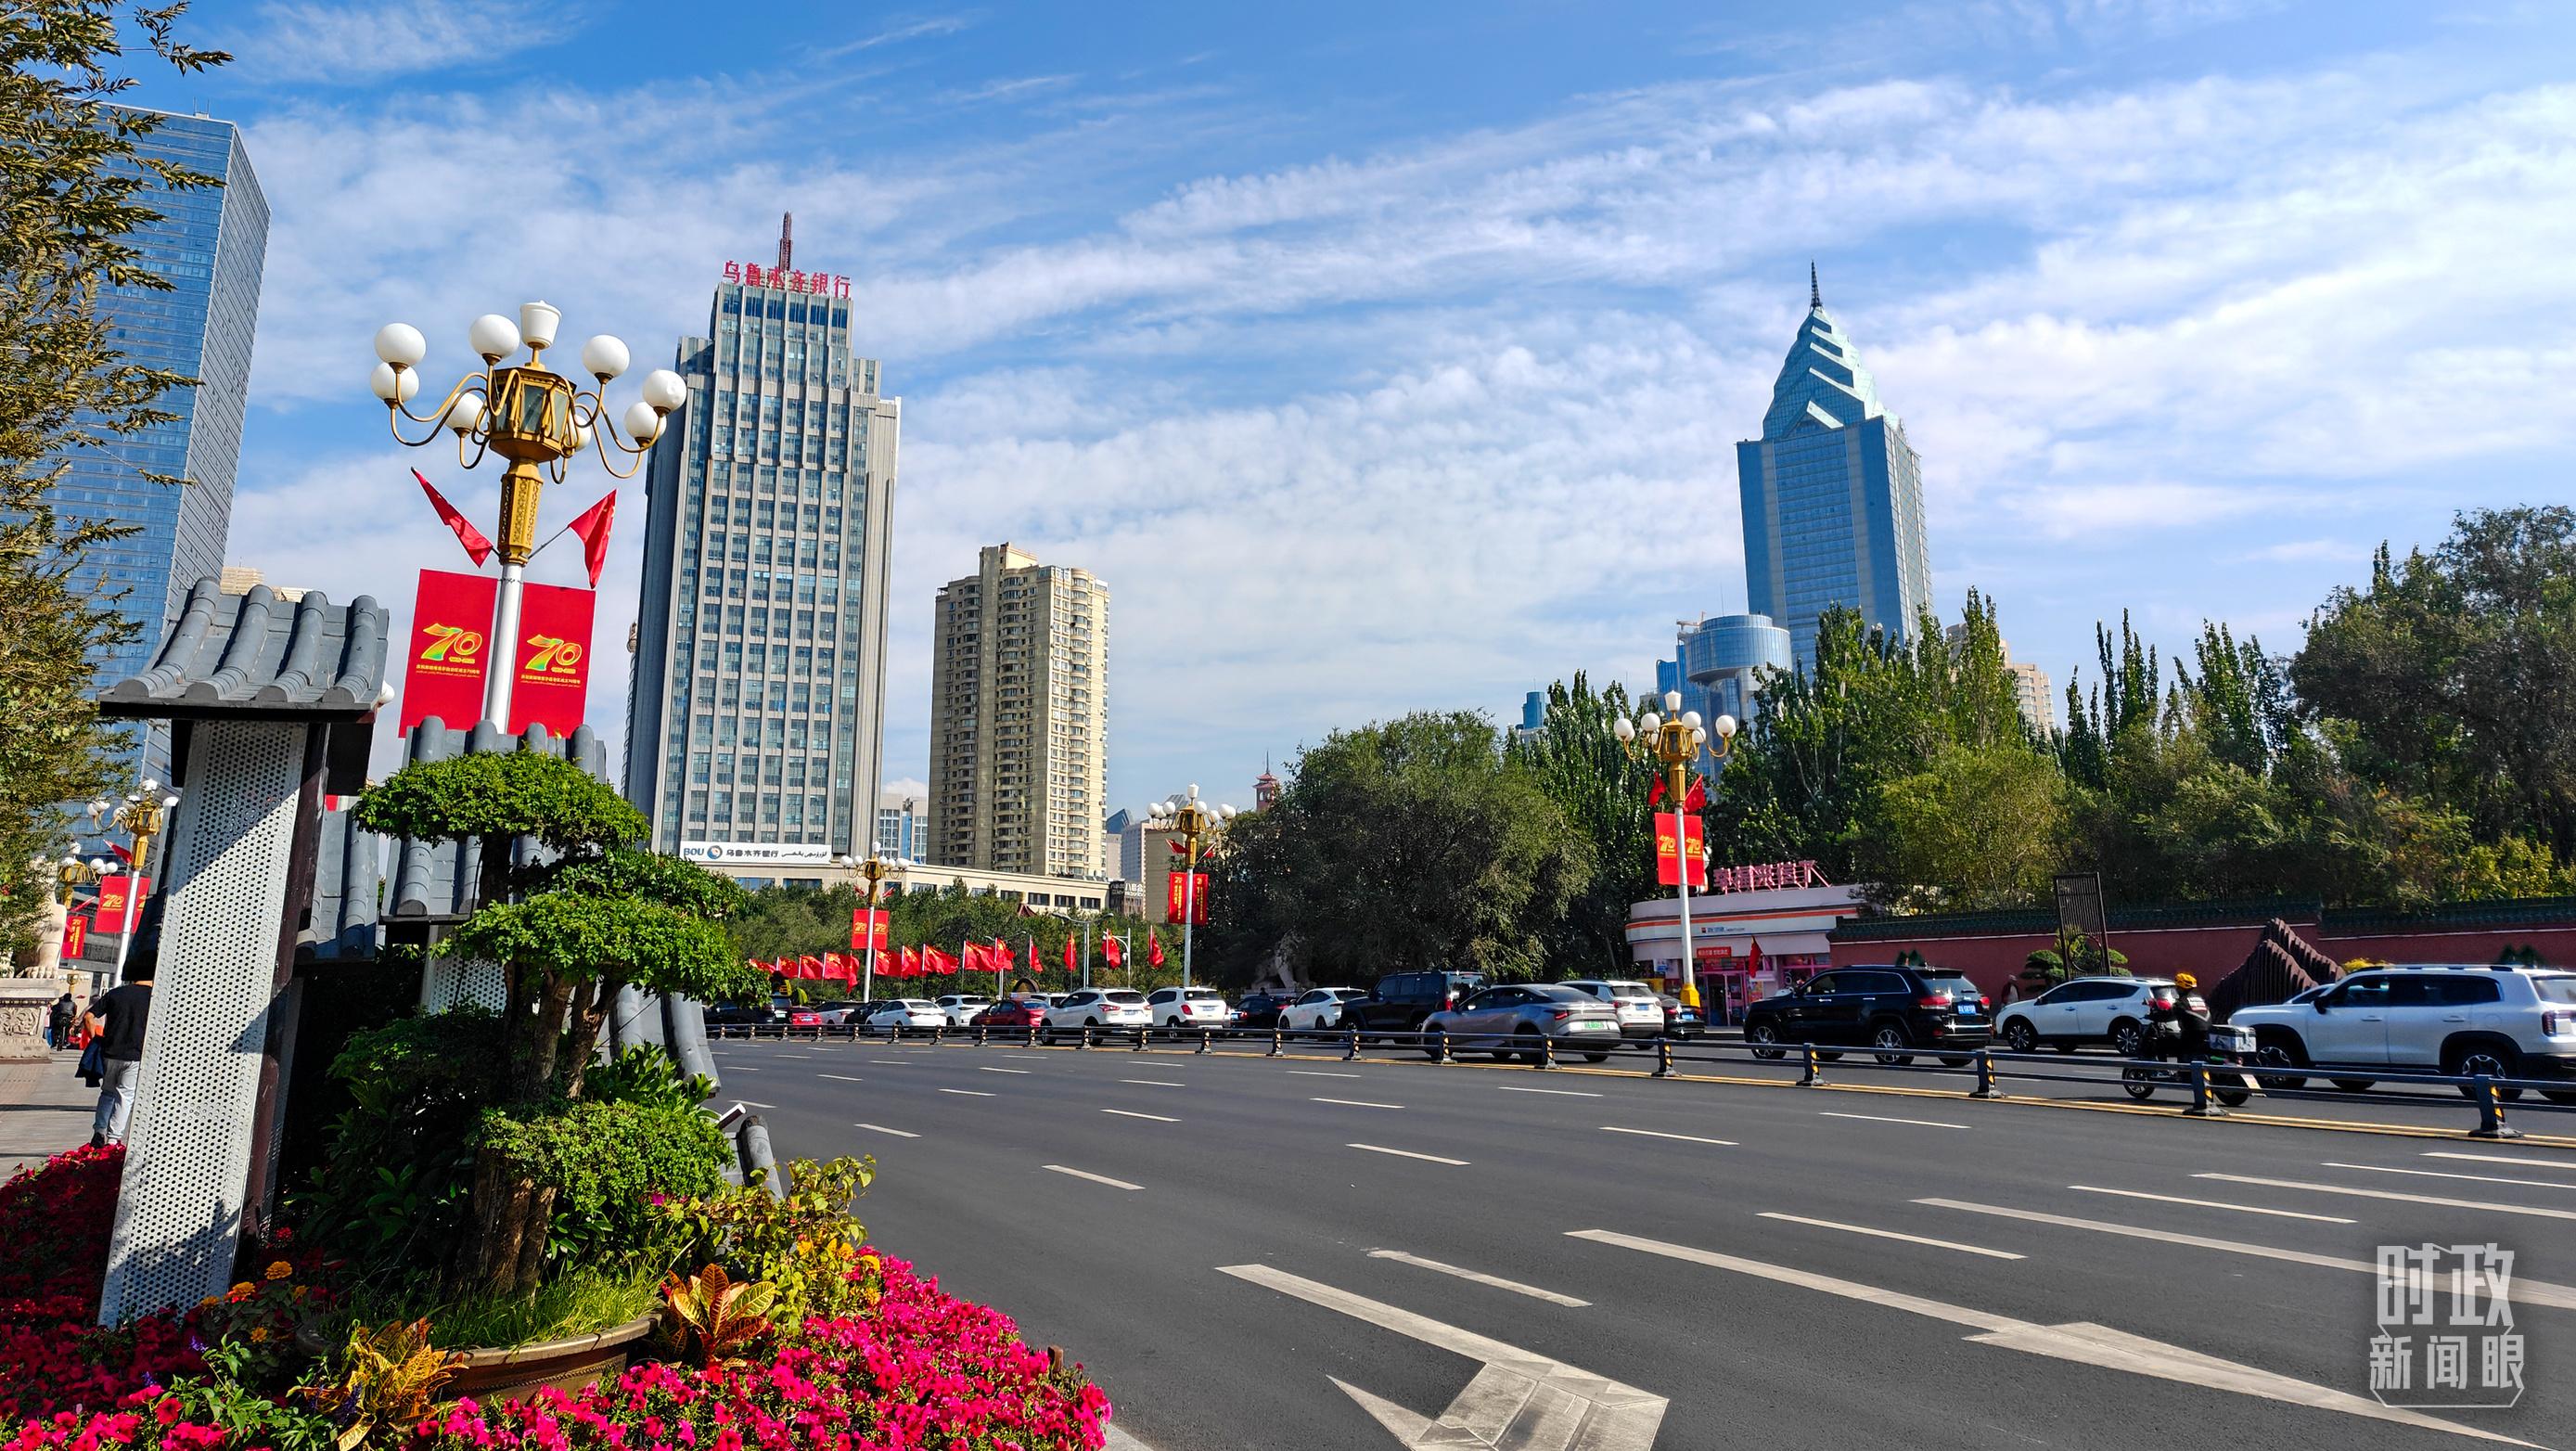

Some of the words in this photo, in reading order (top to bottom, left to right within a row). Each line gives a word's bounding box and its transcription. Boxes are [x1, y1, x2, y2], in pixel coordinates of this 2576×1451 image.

[723, 260, 851, 299] 乌鲁木齐银行
[420, 623, 482, 661] 70
[524, 634, 583, 672] 70
[683, 847, 704, 856] BOU
[1659, 835, 1676, 852] 70
[1685, 837, 1701, 854] 70
[725, 849, 779, 858] 乌鲁木齐银行
